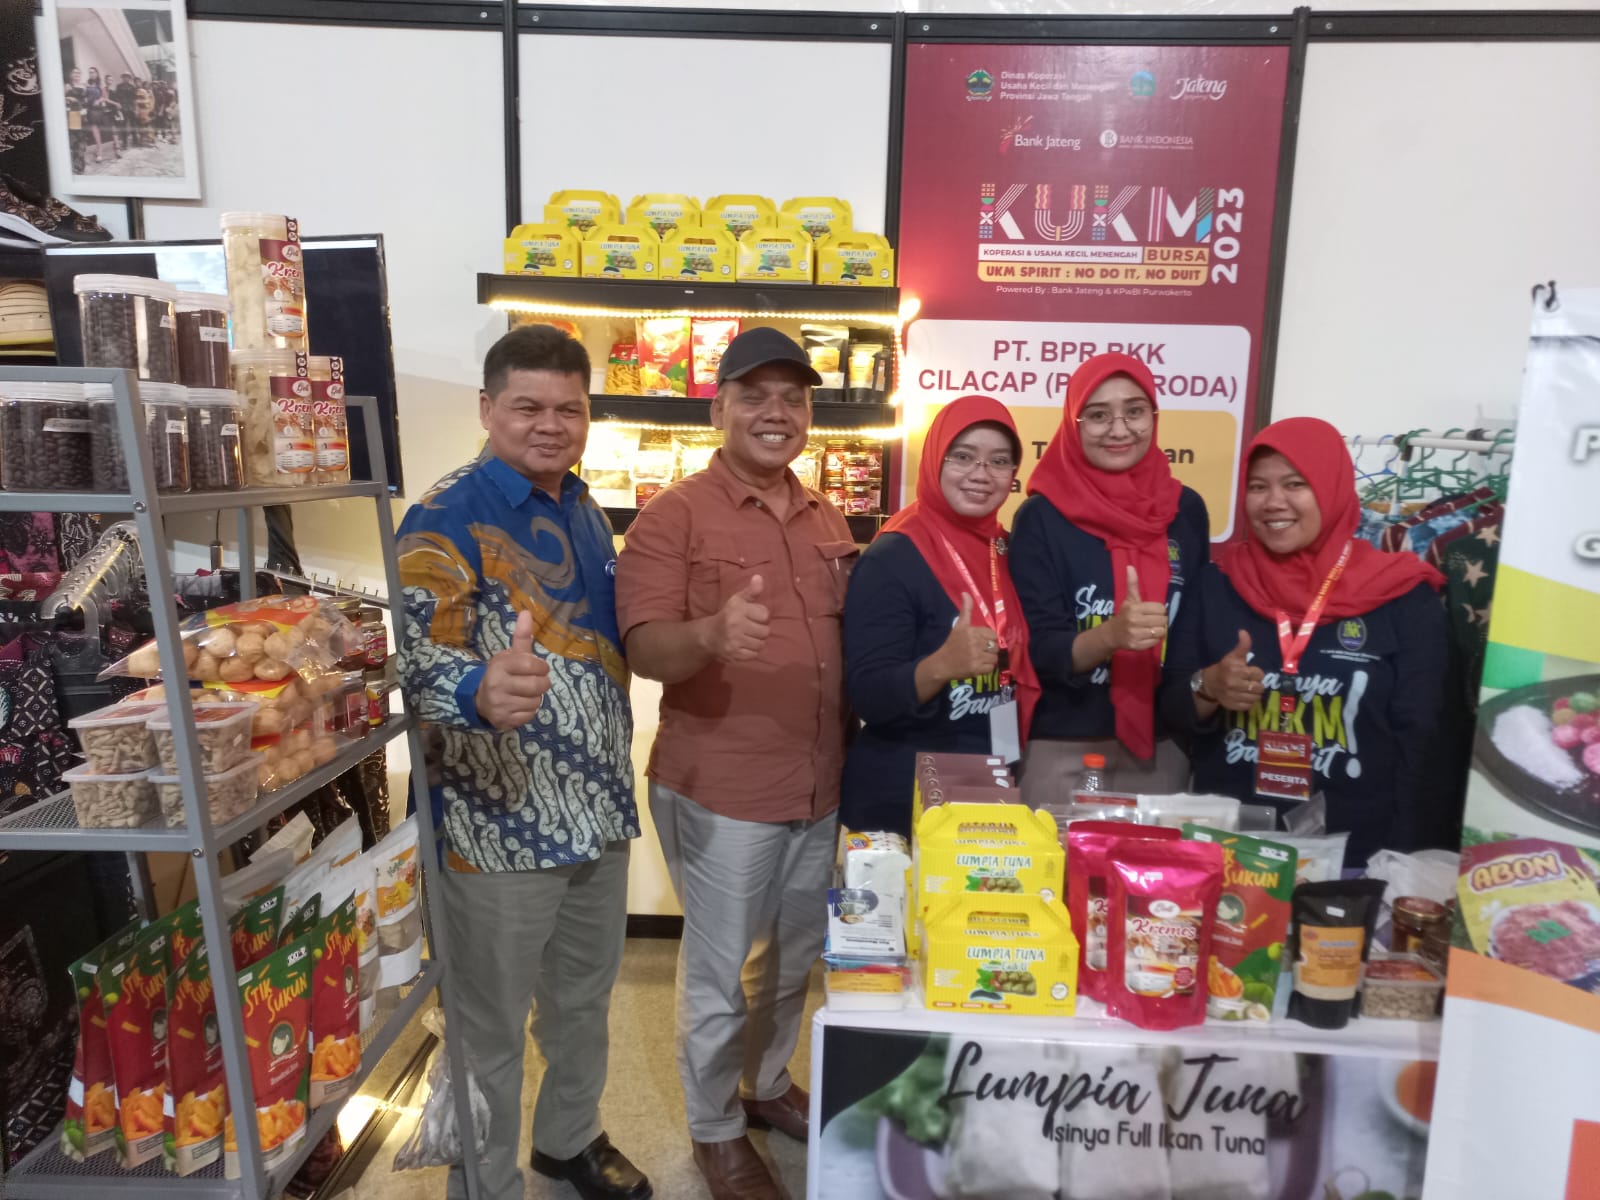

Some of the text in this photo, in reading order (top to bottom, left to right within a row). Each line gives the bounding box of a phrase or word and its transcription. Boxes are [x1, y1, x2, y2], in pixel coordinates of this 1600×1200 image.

[1001, 71, 1067, 82] Dinas Koperasi
[1000, 82, 1027, 90] Usaha
[1029, 82, 1052, 90] Kecil
[1169, 74, 1228, 101] Jateng
[1000, 92, 1035, 100] Provinsi
[1037, 92, 1059, 101] Jawa
[1061, 92, 1093, 102] Tengah
[1014, 134, 1081, 150] Bank Jateng
[1119, 135, 1194, 145] BANK INDONESIA
[1211, 187, 1245, 285] 2023
[983, 248, 1025, 257] KOPERASI
[1090, 251, 1138, 259] MENENGAH
[1147, 249, 1207, 262] BURSA
[986, 266, 1015, 277] UKM
[1020, 266, 1062, 278] SPIRIT
[1075, 268, 1096, 279] NO
[1099, 268, 1120, 279] DO
[1124, 269, 1141, 280] IT,
[1145, 269, 1167, 280] NO
[1170, 269, 1202, 281] DUIT
[996, 285, 1034, 294] Powered
[1051, 286, 1073, 294] Bank
[1075, 287, 1104, 296] Jateng
[993, 339, 1031, 361] PT.
[1040, 340, 1097, 362] BPR
[918, 369, 1037, 393] CILACAP
[1261, 771, 1309, 787] PESERTA
[956, 854, 1032, 868] LUMPIA TUNA
[1222, 864, 1279, 889] SUKUN
[1471, 852, 1562, 892] ABON
[1131, 917, 1197, 940] Kremes
[967, 947, 1045, 961] LUMPIA TUNA
[244, 971, 308, 1024] STIK SUKUN
[936, 1040, 1311, 1139] Lumpia Tuna
[1048, 1120, 1266, 1156] Isinya Full Ikan Tuna
